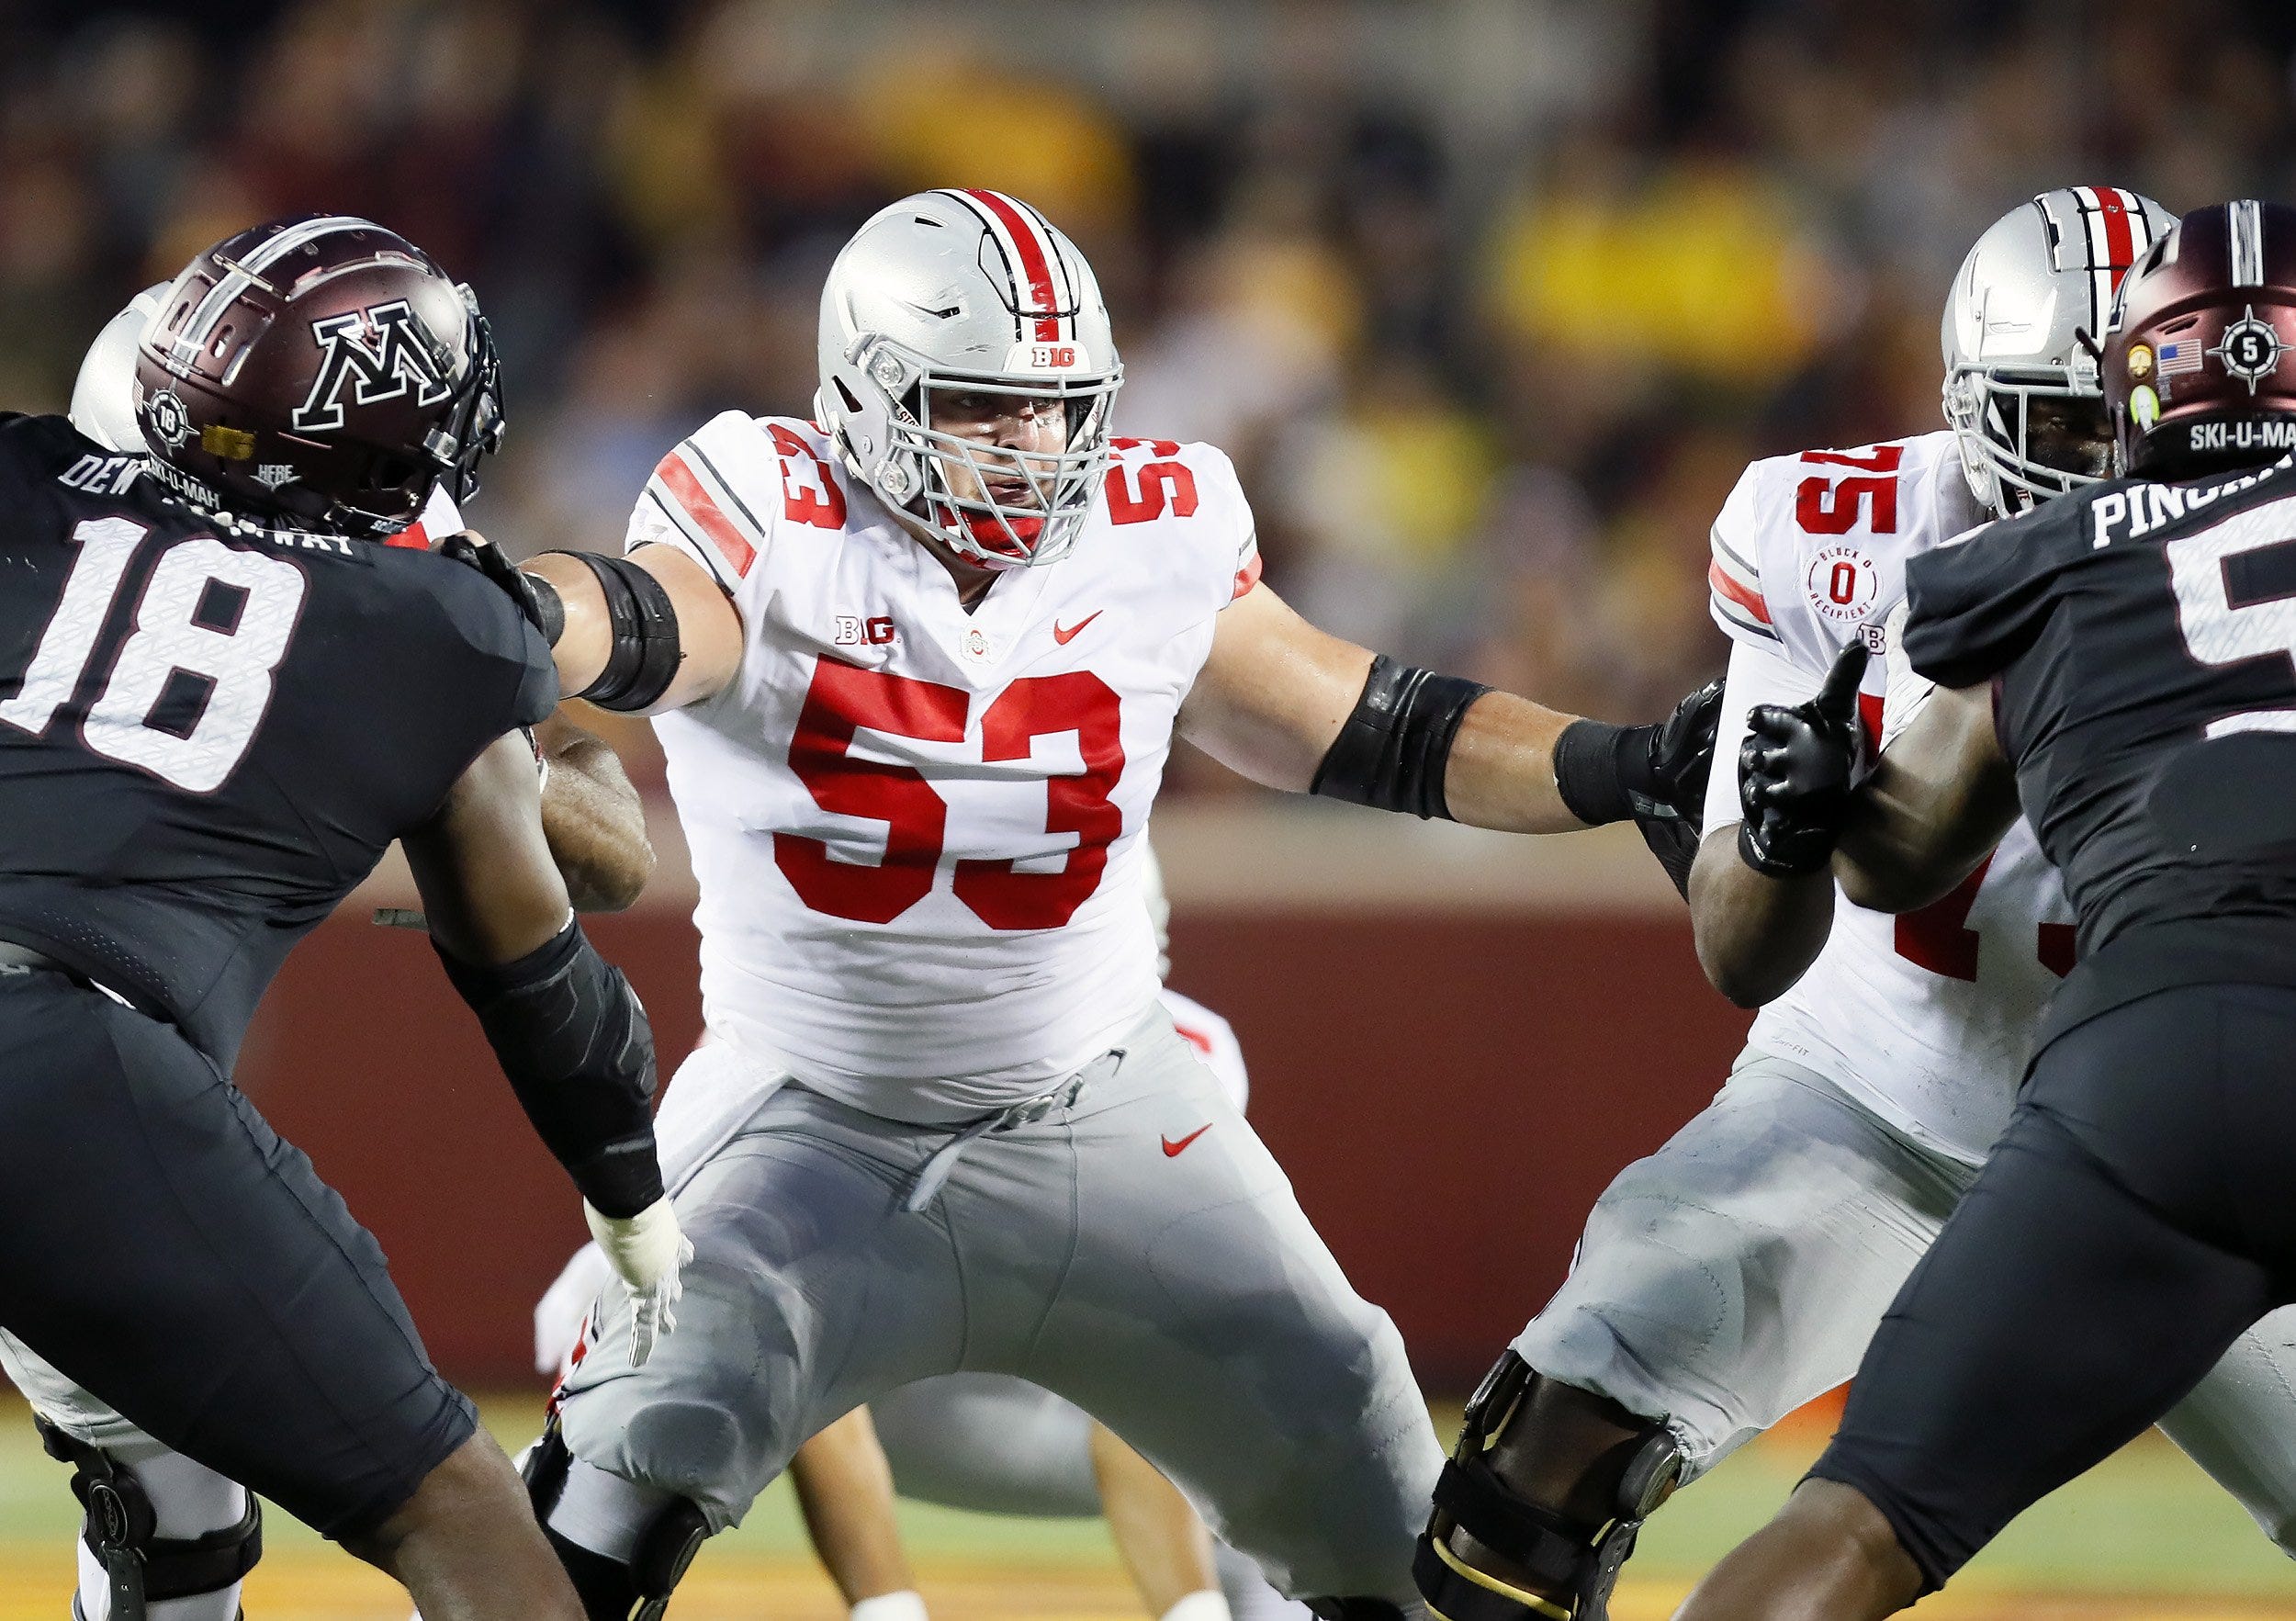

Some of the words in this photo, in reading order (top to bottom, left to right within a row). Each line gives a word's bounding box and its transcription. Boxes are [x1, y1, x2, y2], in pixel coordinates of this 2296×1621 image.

[292, 298, 453, 432] M
[2242, 336, 2259, 363] 5
[161, 405, 176, 433] 18
[258, 464, 294, 484] HERE
[1795, 445, 1904, 535] 75
[1819, 546, 1860, 561] BLOCK
[1810, 592, 1872, 620] RECIPIENT
[2167, 495, 2296, 740] 5
[0, 516, 306, 793] 18
[773, 651, 1126, 930] 53
